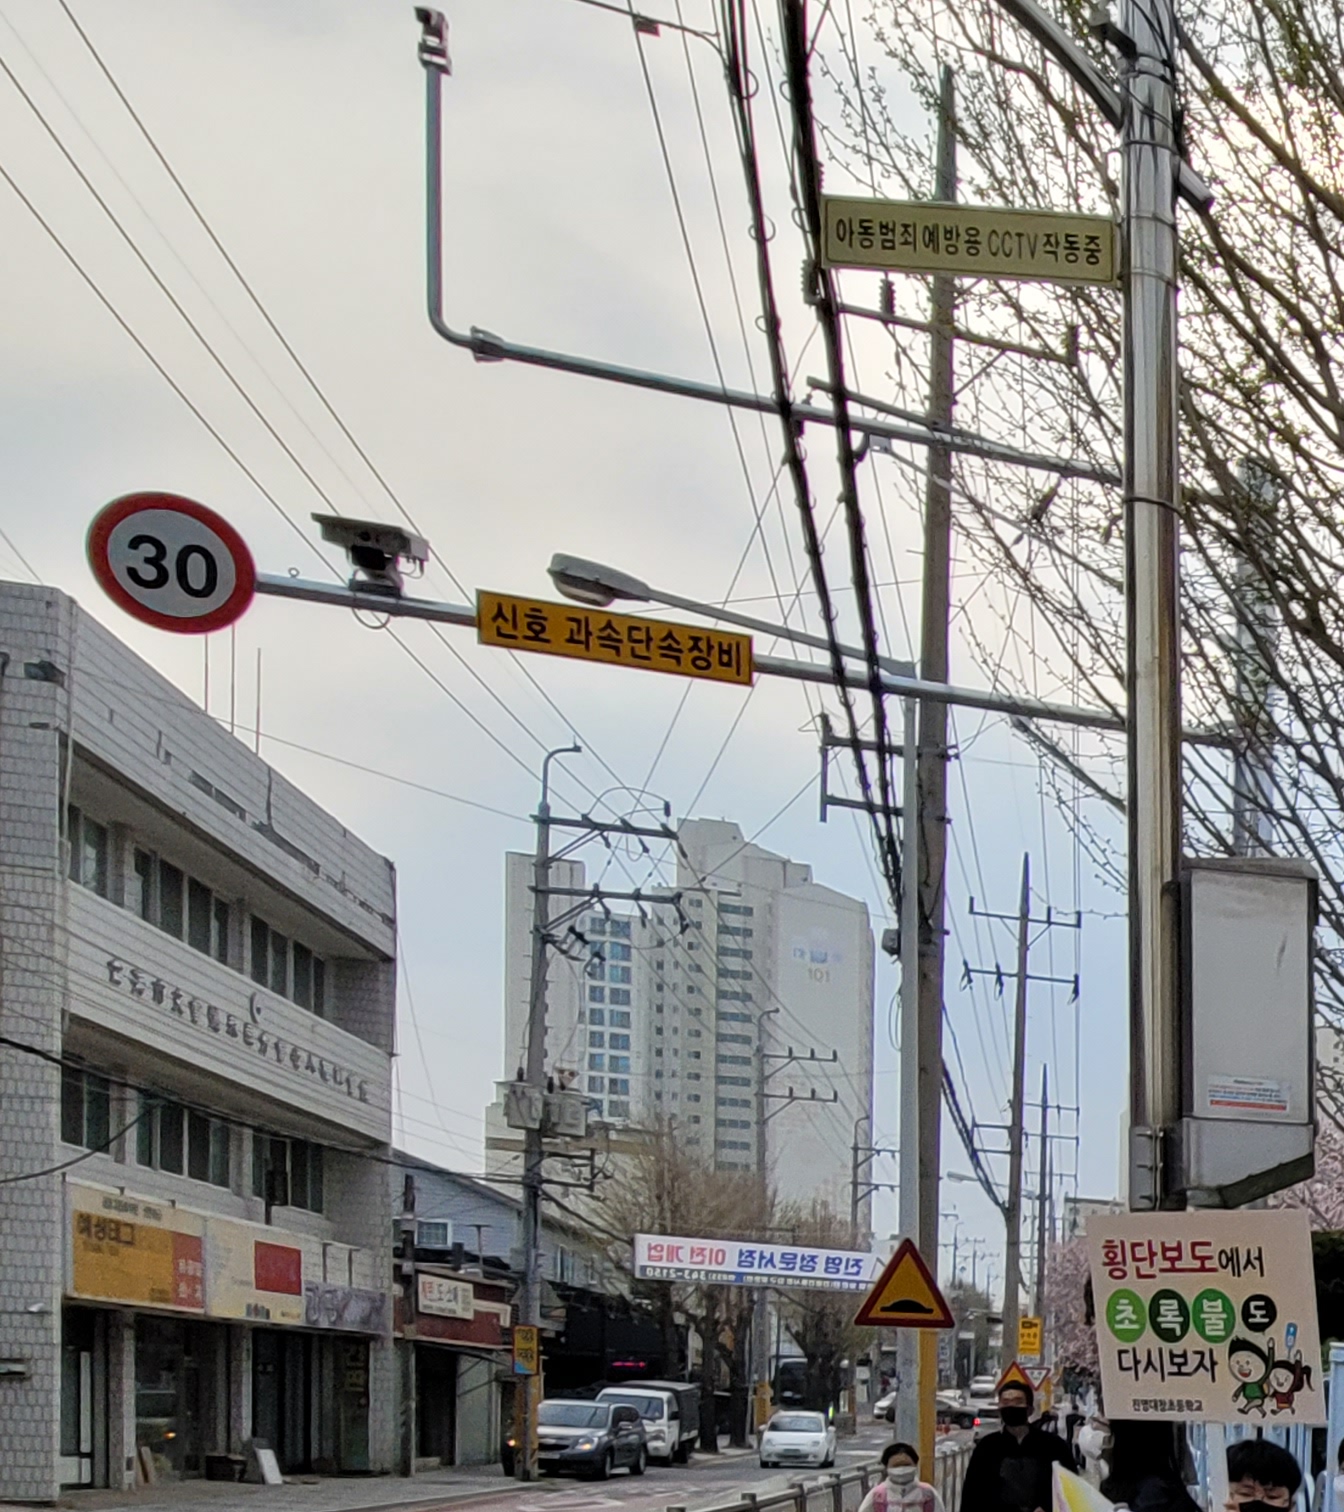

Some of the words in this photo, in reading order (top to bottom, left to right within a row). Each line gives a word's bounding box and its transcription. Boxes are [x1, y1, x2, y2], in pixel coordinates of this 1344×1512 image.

[988, 230, 1038, 260] CCTV
[126, 534, 219, 600] 30
[491, 602, 552, 643] 신호
[564, 615, 742, 677] 과속단속장비
[1102, 1239, 1265, 1280] 횡단보도에서
